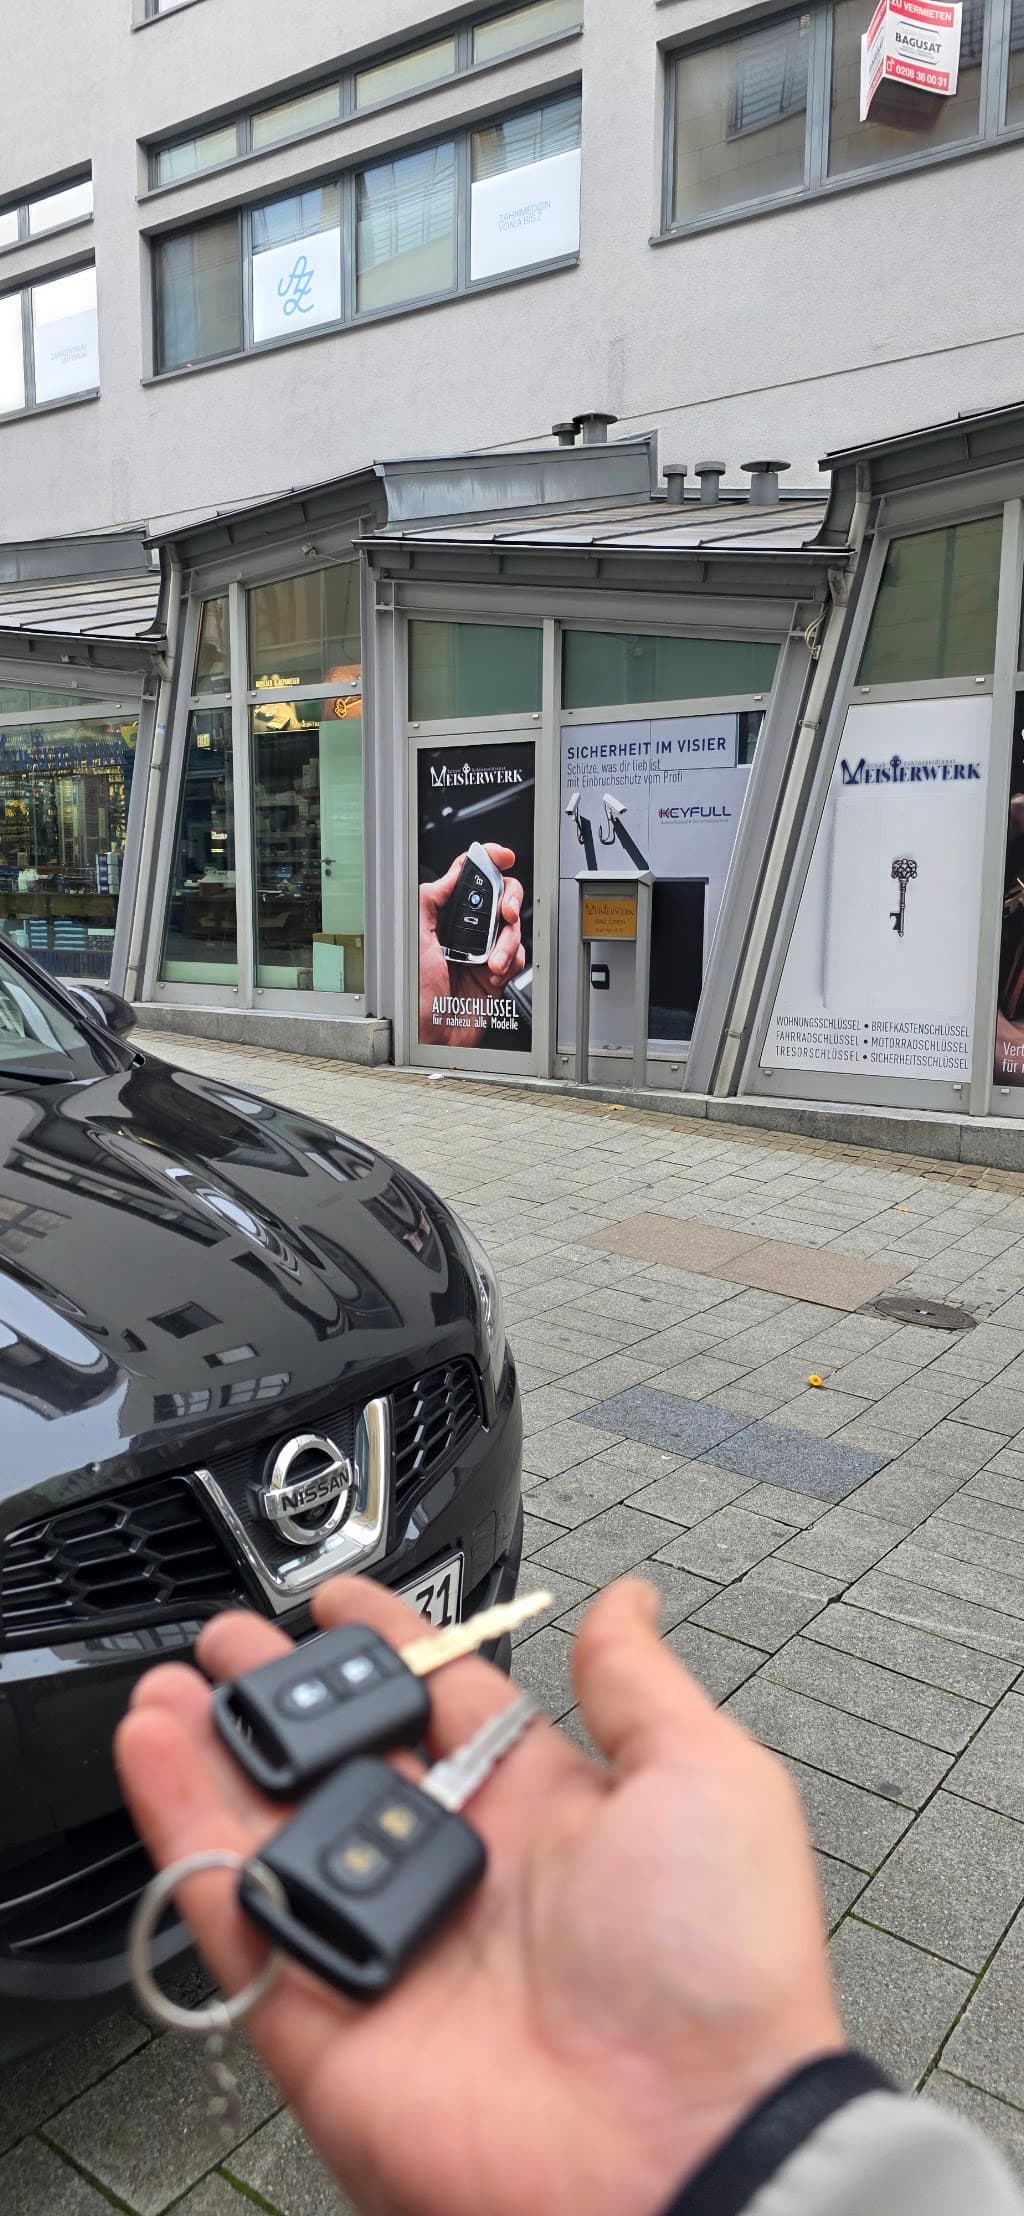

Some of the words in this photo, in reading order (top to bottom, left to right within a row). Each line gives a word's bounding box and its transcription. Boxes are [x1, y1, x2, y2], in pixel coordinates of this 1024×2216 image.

[903, 3, 952, 20] VERMIETEN
[895, 32, 942, 54] BAGUSAT
[895, 64, 915, 79] 0208
[916, 71, 927, 82] 36
[927, 73, 937, 85] 00
[937, 76, 948, 87] 31
[567, 742, 650, 760] SICHERHEIT
[656, 740, 672, 754] IM
[678, 737, 726, 753] VISIER
[430, 763, 523, 787] MEISTERWERK
[567, 761, 600, 776] Schütze,
[602, 763, 618, 774] was
[619, 760, 630, 772] dir
[633, 758, 648, 771] lieb
[650, 758, 661, 771] ist
[841, 755, 982, 785] MEISTERWERK
[567, 776, 580, 788] mit
[582, 773, 642, 788] Einbruchsschutz
[643, 773, 661, 785] vom
[663, 771, 683, 784] Profi
[658, 805, 732, 819] KEYFULL
[432, 995, 519, 1018] AUTOSCHLÜSSEL
[432, 1014, 442, 1026] für
[446, 1014, 471, 1028] nahezu
[474, 1016, 487, 1029] alle
[491, 1016, 519, 1031] Modelle
[776, 1015, 861, 1031] WOHNUNGSSCHLÜSSEL
[871, 1020, 970, 1038] BRIEFKASTENSCHLÜSSEL
[776, 1031, 859, 1047] FAHRRADSCHLÜSSEL
[871, 1037, 969, 1054] MOTORRADSCHLÜSSEL
[775, 1045, 860, 1062] TRESORSCHLÜSSEL
[870, 1053, 969, 1070] SICHERHEITSSCHLÜSSEL
[1002, 1058, 1018, 1073] für
[281, 1471, 350, 1512] NISSAN
